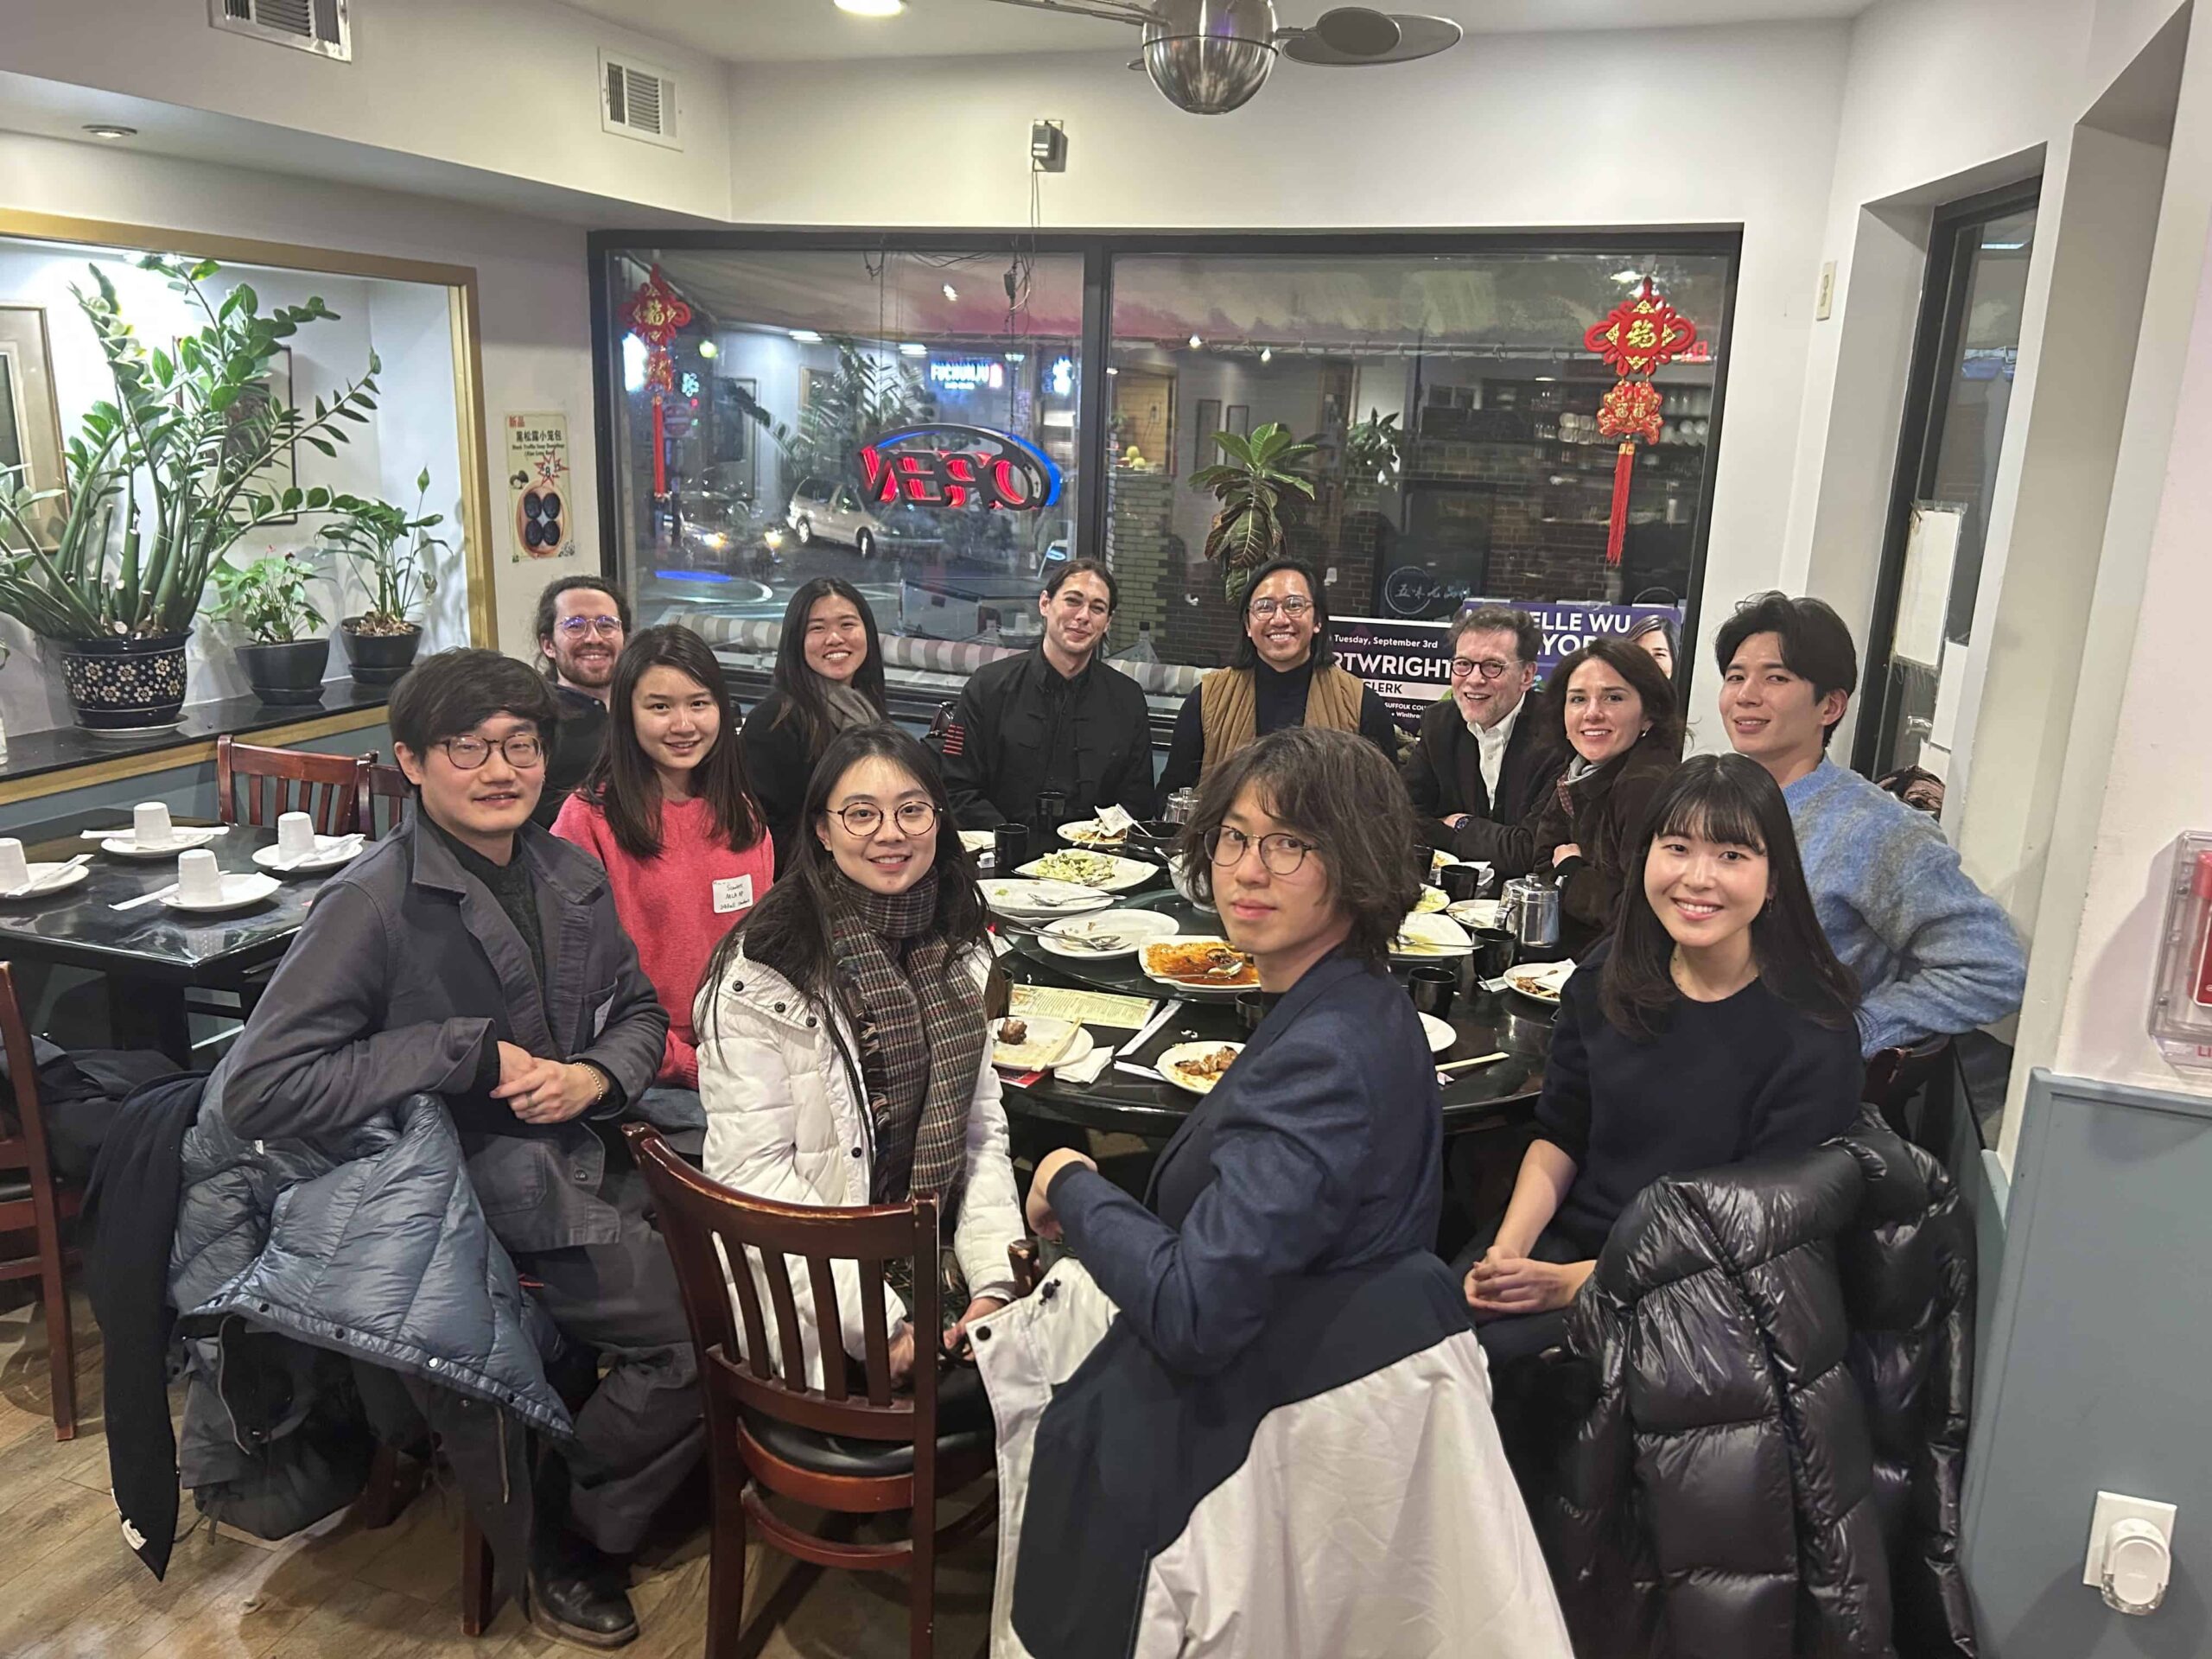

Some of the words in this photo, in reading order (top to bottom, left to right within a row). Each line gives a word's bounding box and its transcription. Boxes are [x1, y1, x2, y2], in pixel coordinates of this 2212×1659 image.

[643, 299, 665, 326] 福
[1626, 319, 1657, 348] 福
[509, 416, 525, 428] 新品
[1588, 613, 1630, 633] WU
[1334, 634, 1371, 645] Tuesday,
[1373, 637, 1421, 647] September
[1422, 639, 1438, 649] 3rd
